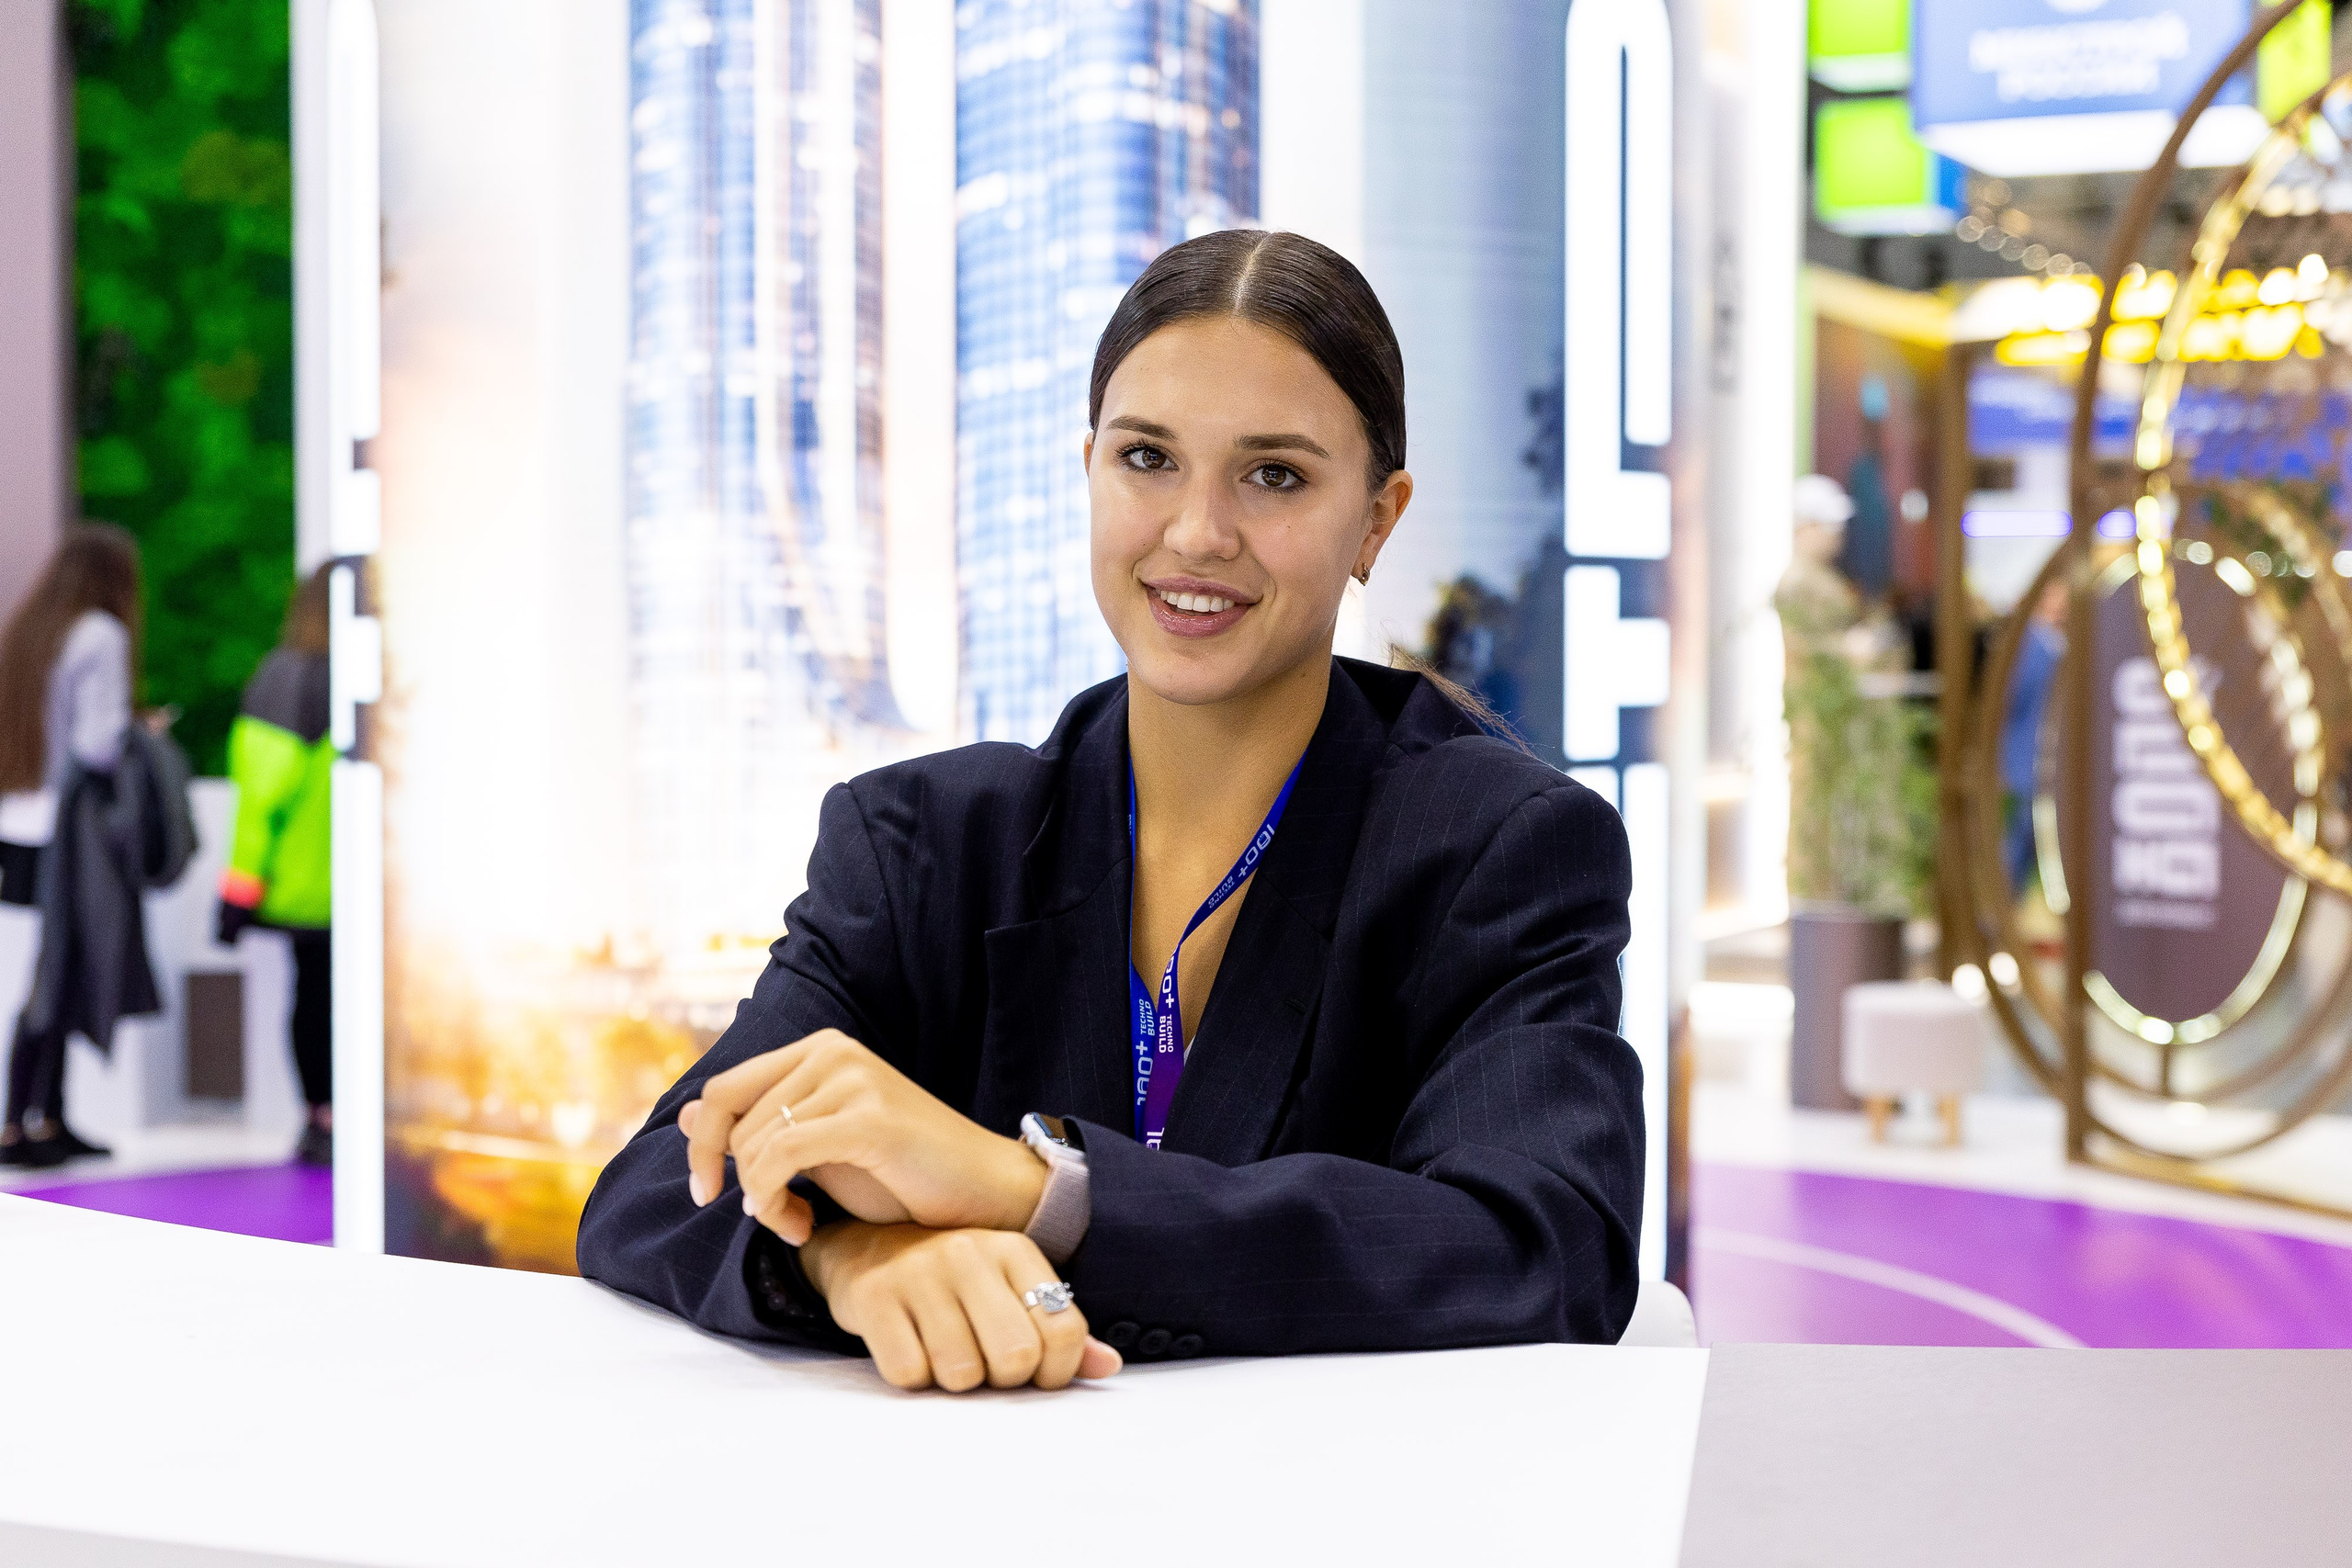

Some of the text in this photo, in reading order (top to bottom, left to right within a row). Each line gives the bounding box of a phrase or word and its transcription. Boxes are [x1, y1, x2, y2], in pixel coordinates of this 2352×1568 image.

[1238, 824, 1275, 878] 100+
[1208, 875, 1234, 905] BUILD
[1209, 881, 1236, 909] TECHNO
[1138, 998, 1148, 1035] TECHNO
[1145, 1000, 1156, 1036] BUILD
[1159, 1015, 1167, 1054] BUILD
[1166, 1014, 1174, 1053] TECHNO
